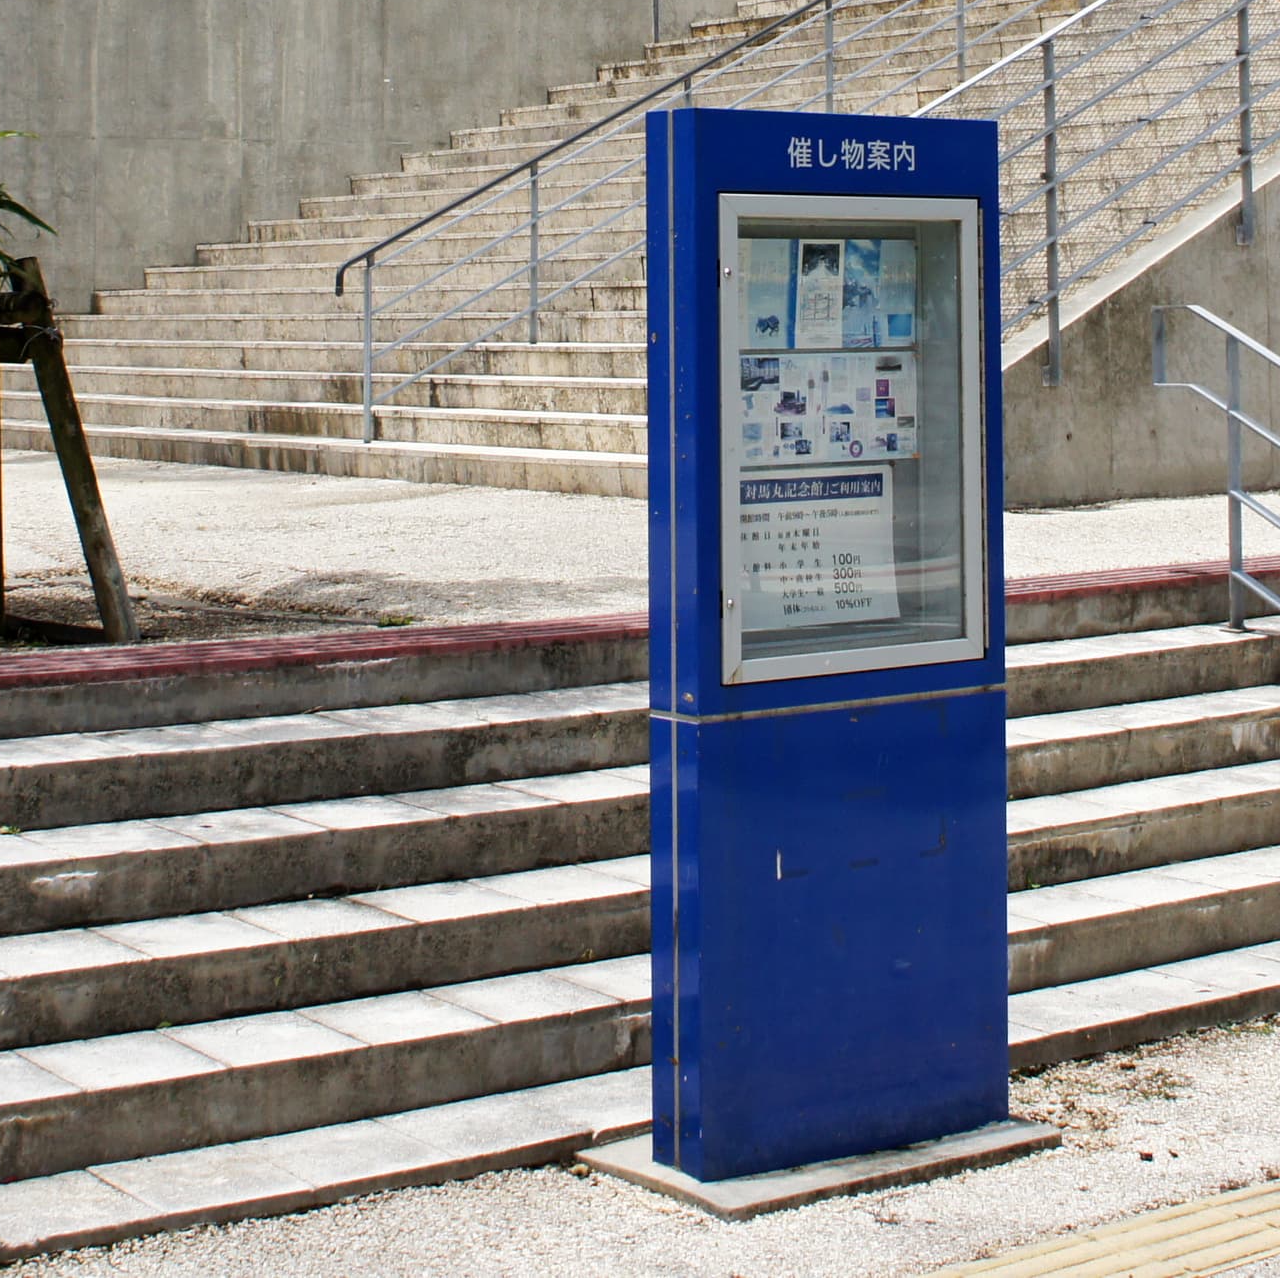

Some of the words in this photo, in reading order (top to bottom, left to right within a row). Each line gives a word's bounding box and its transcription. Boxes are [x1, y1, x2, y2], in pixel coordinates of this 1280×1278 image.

[787, 136, 915, 171] 催し物案内
[832, 553, 861, 566] 100円
[833, 567, 862, 580] 300円
[834, 581, 863, 594] 500円
[836, 598, 872, 610] 10%OFF
